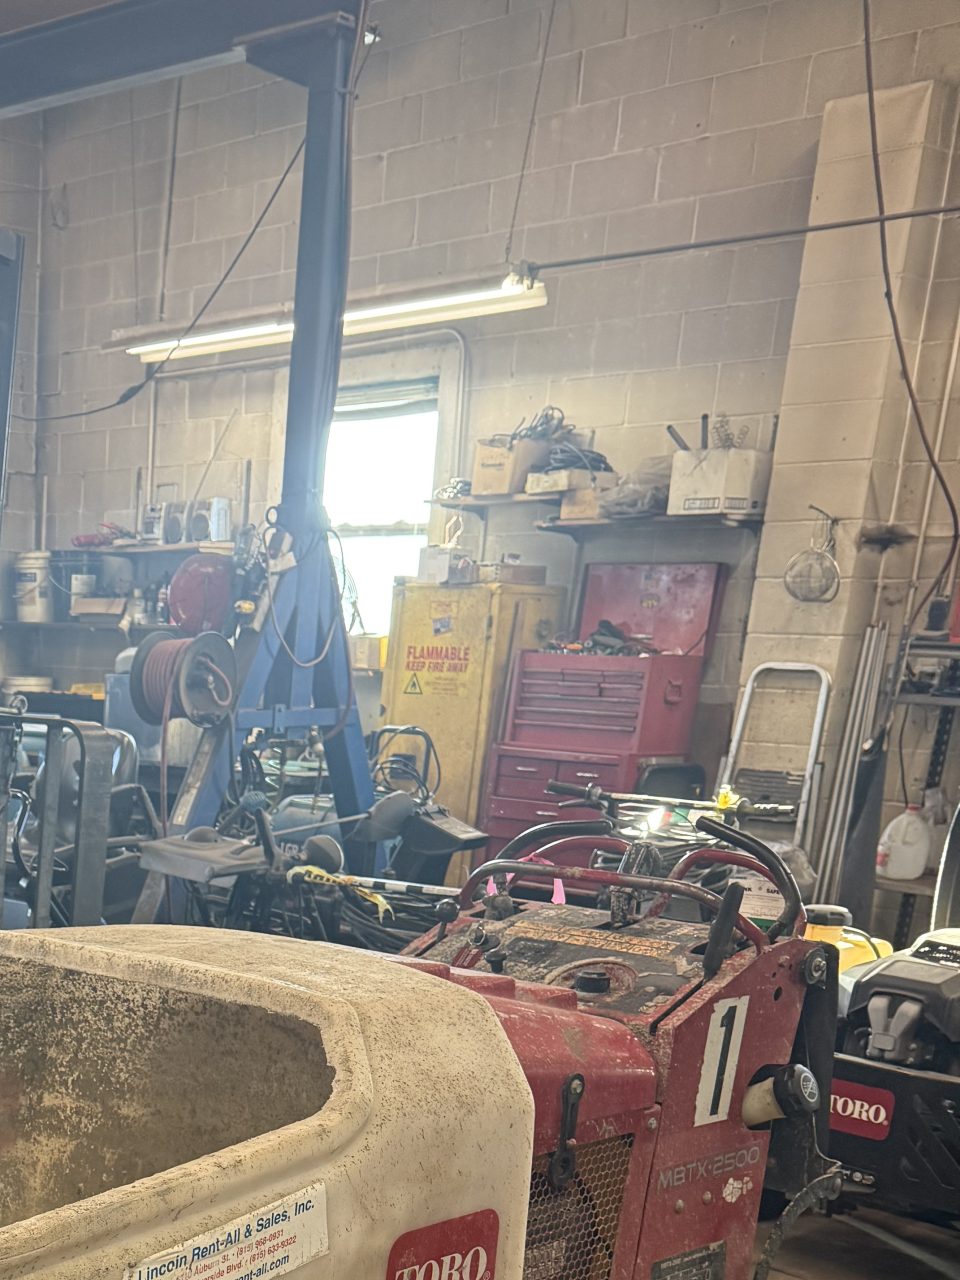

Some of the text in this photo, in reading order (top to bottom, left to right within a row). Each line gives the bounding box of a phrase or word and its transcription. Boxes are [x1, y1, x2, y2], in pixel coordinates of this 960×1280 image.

[405, 661, 469, 673] KEEP FIRE AWAY
[406, 645, 470, 661] FLAMMABLE
[709, 1005, 738, 1117] 1
[191, 1228, 241, 1262] Rent-All
[244, 1223, 253, 1239] &
[256, 1210, 291, 1233] Sales,
[294, 1199, 315, 1217] Inc.
